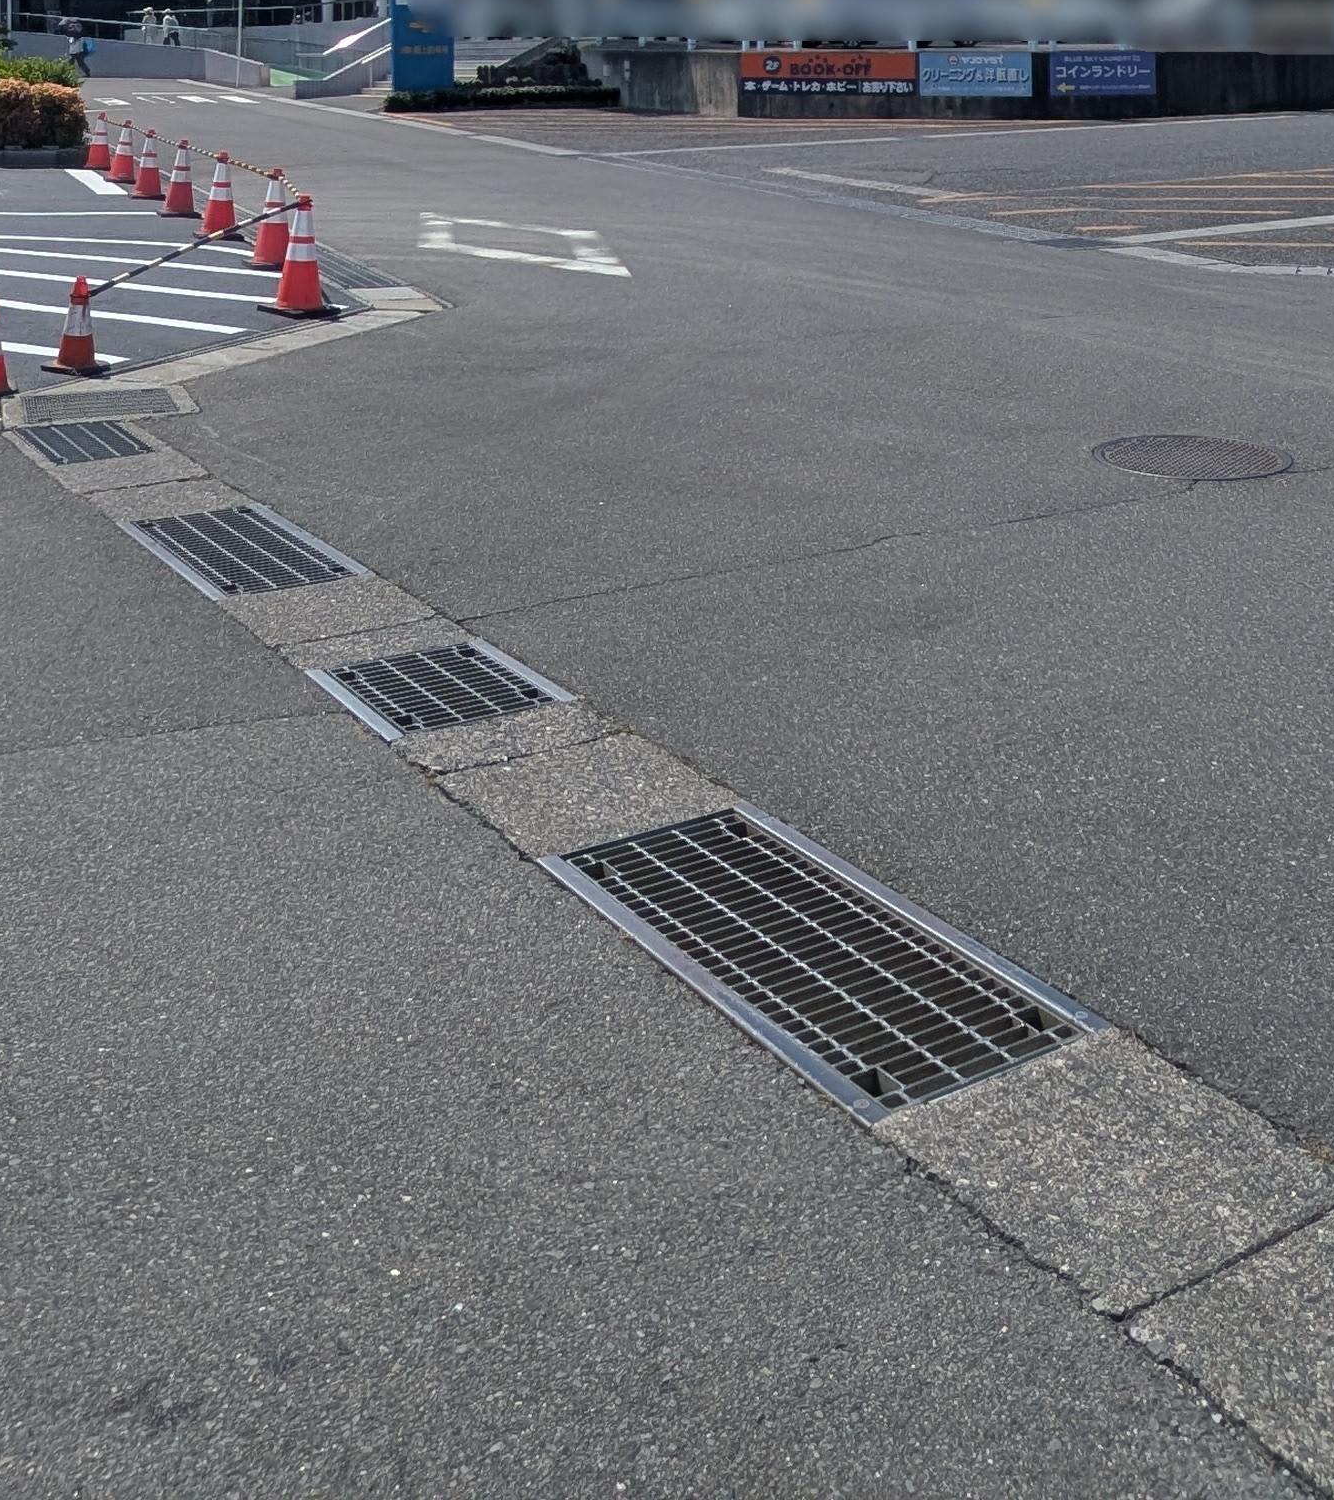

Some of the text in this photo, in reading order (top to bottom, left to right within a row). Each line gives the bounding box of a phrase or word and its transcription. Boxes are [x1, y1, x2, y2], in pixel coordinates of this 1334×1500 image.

[764, 59, 780, 71] 2F
[1055, 65, 1151, 79] コインランドリー
